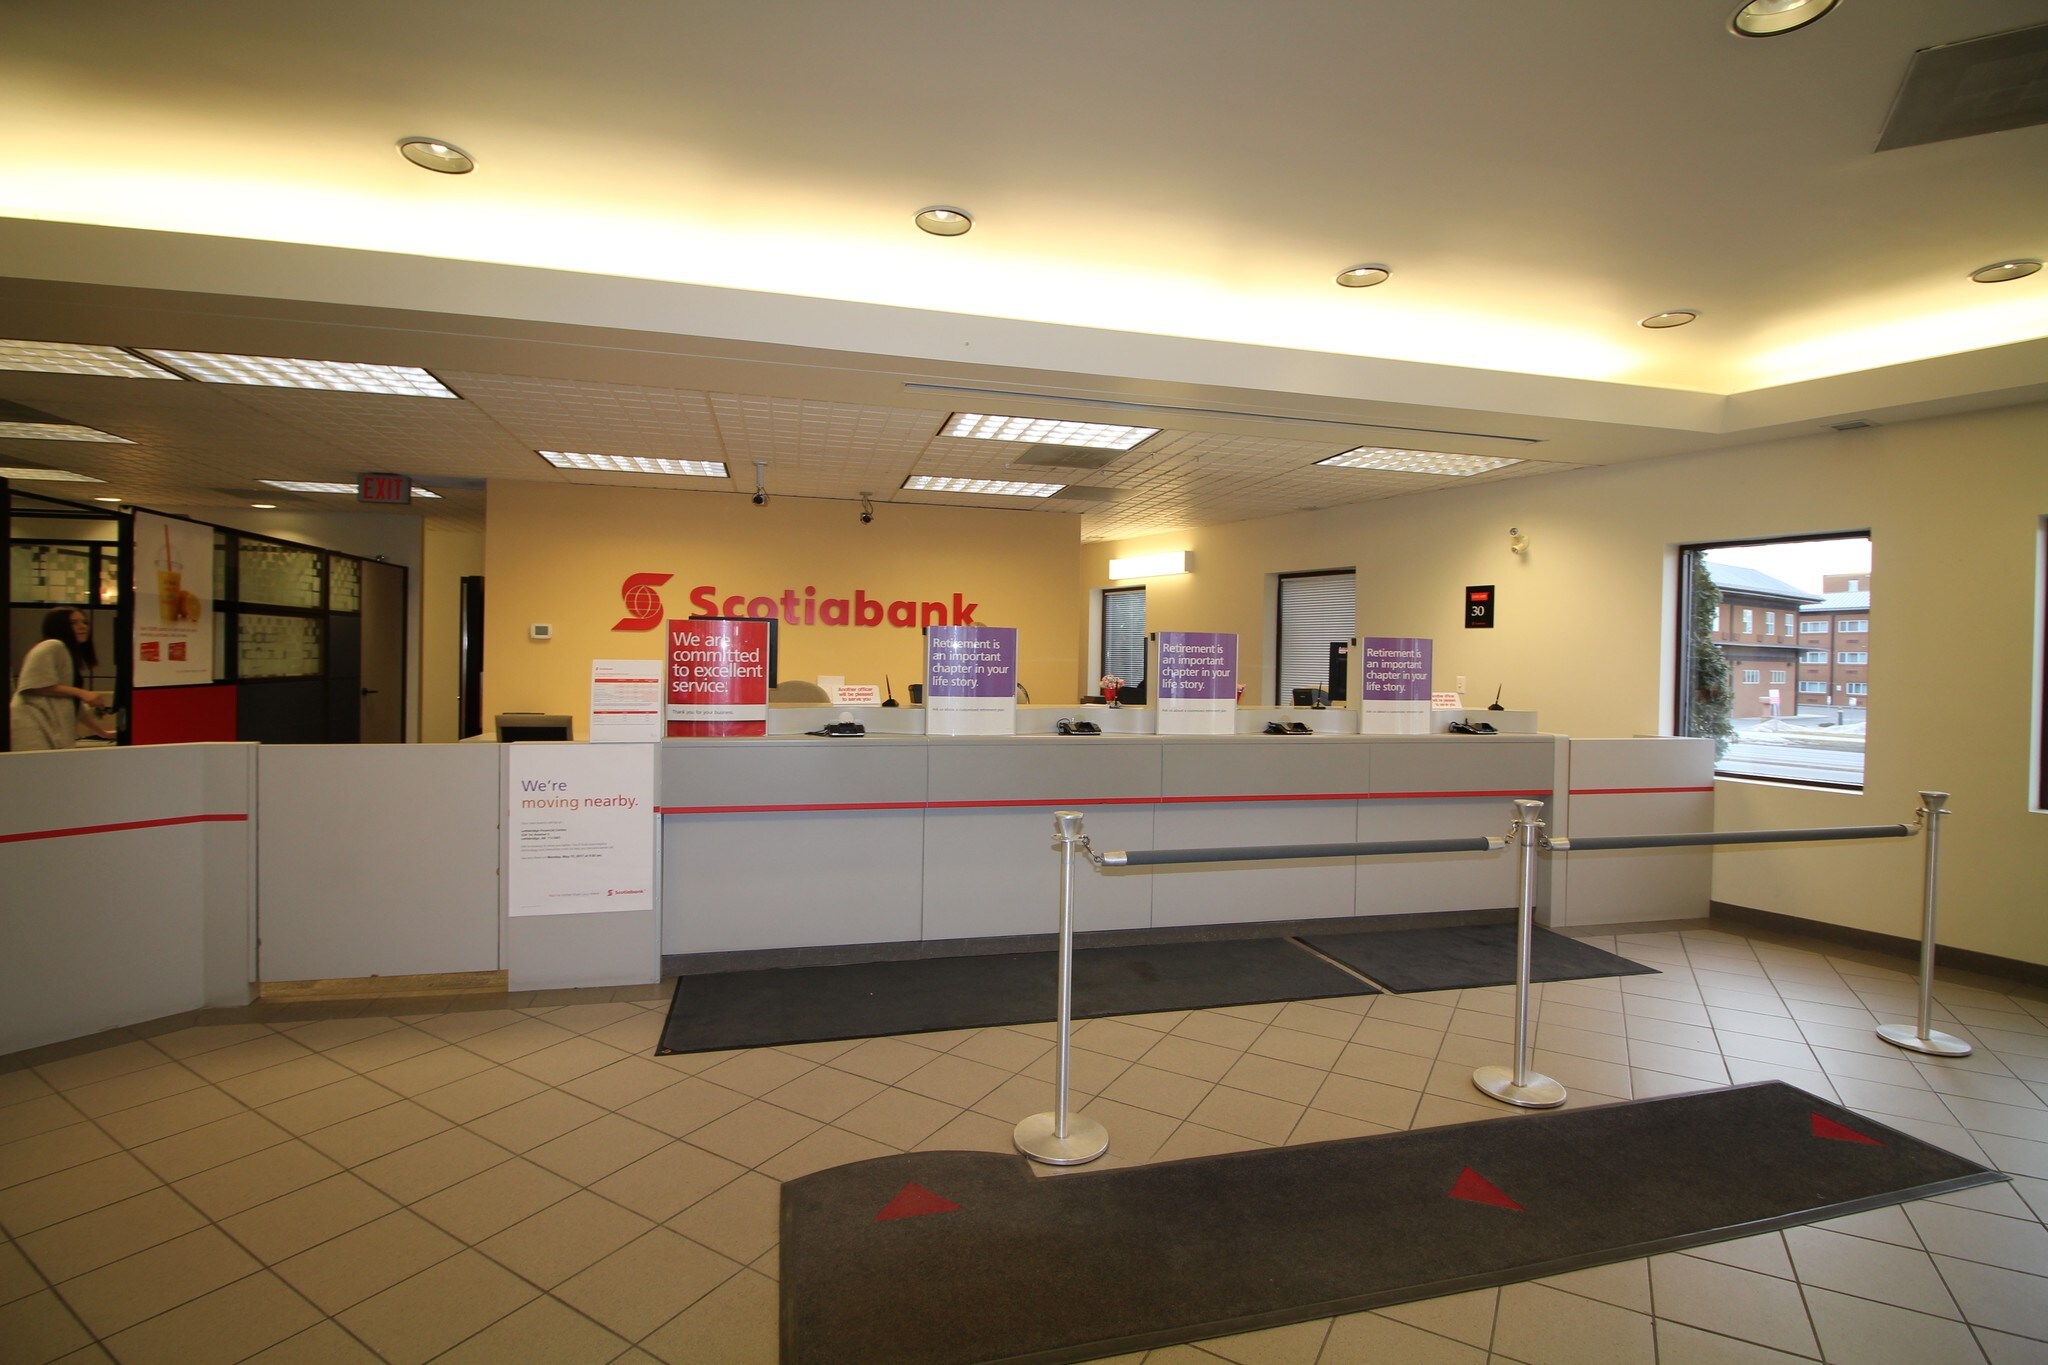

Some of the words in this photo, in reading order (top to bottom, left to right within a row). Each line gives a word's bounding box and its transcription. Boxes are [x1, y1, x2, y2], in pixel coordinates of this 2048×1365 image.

[363, 477, 403, 500] EXIT
[689, 585, 979, 628] Scotiabank
[1471, 605, 1485, 617] 30
[672, 632, 701, 647] We
[705, 635, 731, 648] are
[993, 639, 1001, 649] is
[1162, 643, 1216, 654] Retirement
[1217, 644, 1224, 654] is
[1366, 648, 1415, 658] Retirement
[1415, 649, 1422, 658] is
[672, 648, 760, 663] committed
[932, 652, 946, 661] an
[949, 650, 1001, 663] important
[1162, 656, 1176, 664] an
[1178, 655, 1224, 667] important
[672, 664, 690, 678] to
[693, 663, 763, 678] excellent
[932, 663, 973, 675] chapter
[975, 663, 985, 673] in
[987, 666, 1009, 676] your
[1366, 660, 1379, 668] an
[1381, 659, 1422, 670] important
[1162, 667, 1200, 678] chapter
[1201, 667, 1210, 677] in
[1211, 669, 1231, 679] your
[1366, 670, 1401, 681] chapter
[1402, 671, 1410, 680] in
[1411, 673, 1428, 682] your
[932, 676, 949, 686] life
[951, 677, 979, 689] story.
[1162, 679, 1178, 689] life
[1180, 680, 1205, 691] story.
[1366, 682, 1381, 691] life
[1383, 683, 1406, 693] story.
[521, 796, 579, 811] moving
[584, 794, 639, 809] nearby.
